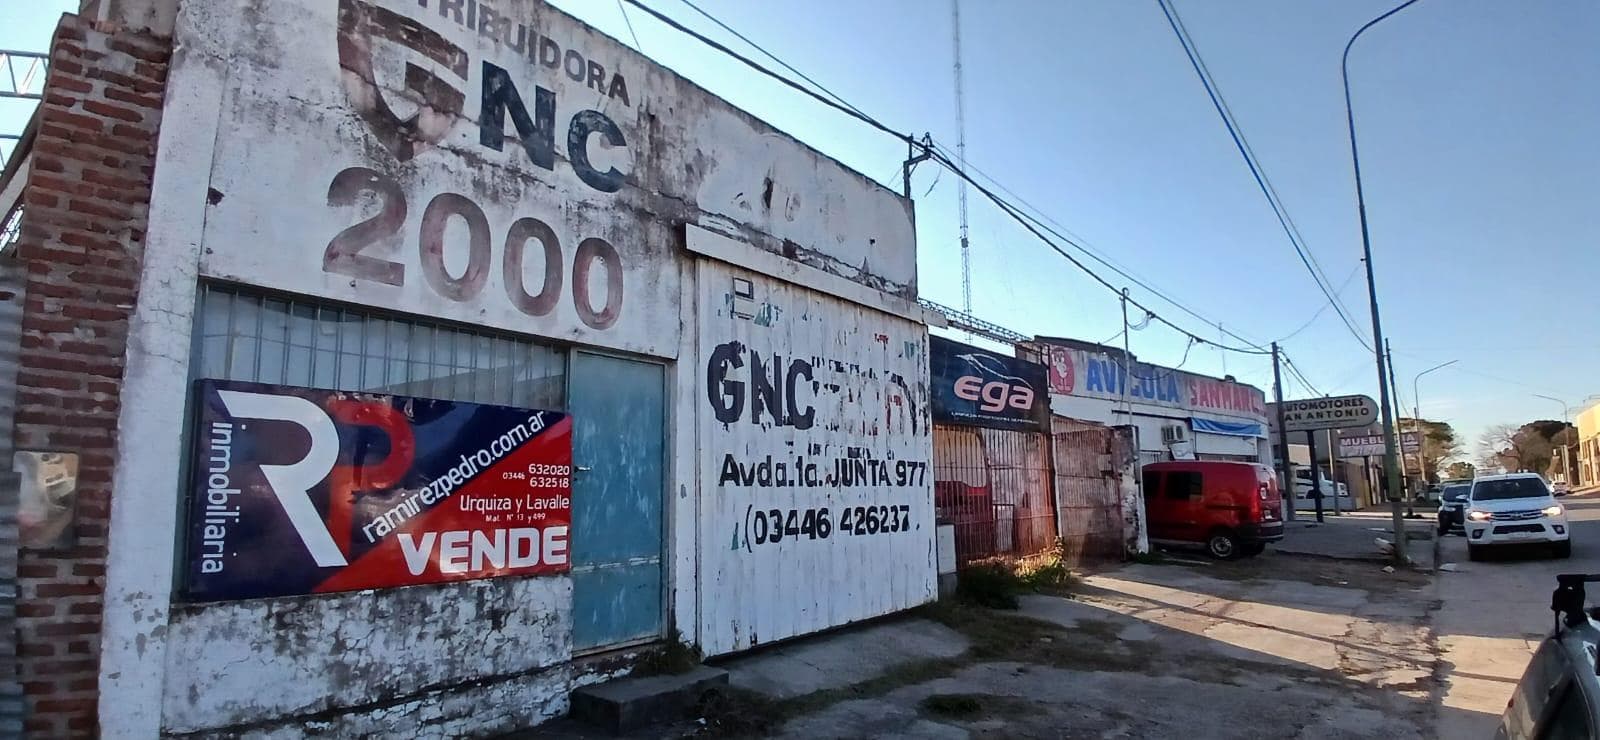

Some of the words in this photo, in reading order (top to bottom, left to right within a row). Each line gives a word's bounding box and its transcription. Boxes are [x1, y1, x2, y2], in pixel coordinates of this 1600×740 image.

[418, 0, 630, 107] RIBUIDORA
[323, 166, 624, 331] 2000
[707, 341, 816, 430] GNC
[953, 374, 1034, 413] ega
[1284, 413, 1302, 421] AN
[1306, 407, 1369, 420] ANTONIO
[1285, 397, 1364, 412] UTOMOTORES
[362, 411, 545, 544] ramirezpedro.com.ar
[502, 471, 526, 480] 03446
[529, 477, 570, 488] 632518
[528, 463, 570, 476] 632020
[831, 457, 891, 488] JUNTA
[895, 460, 926, 487] 977
[201, 421, 248, 574] inmobiliaria
[460, 494, 511, 514] Urquiza
[515, 499, 523, 513] y
[526, 494, 570, 510] Lavalle
[839, 504, 910, 536] 426237
[398, 525, 569, 576] VENDE
